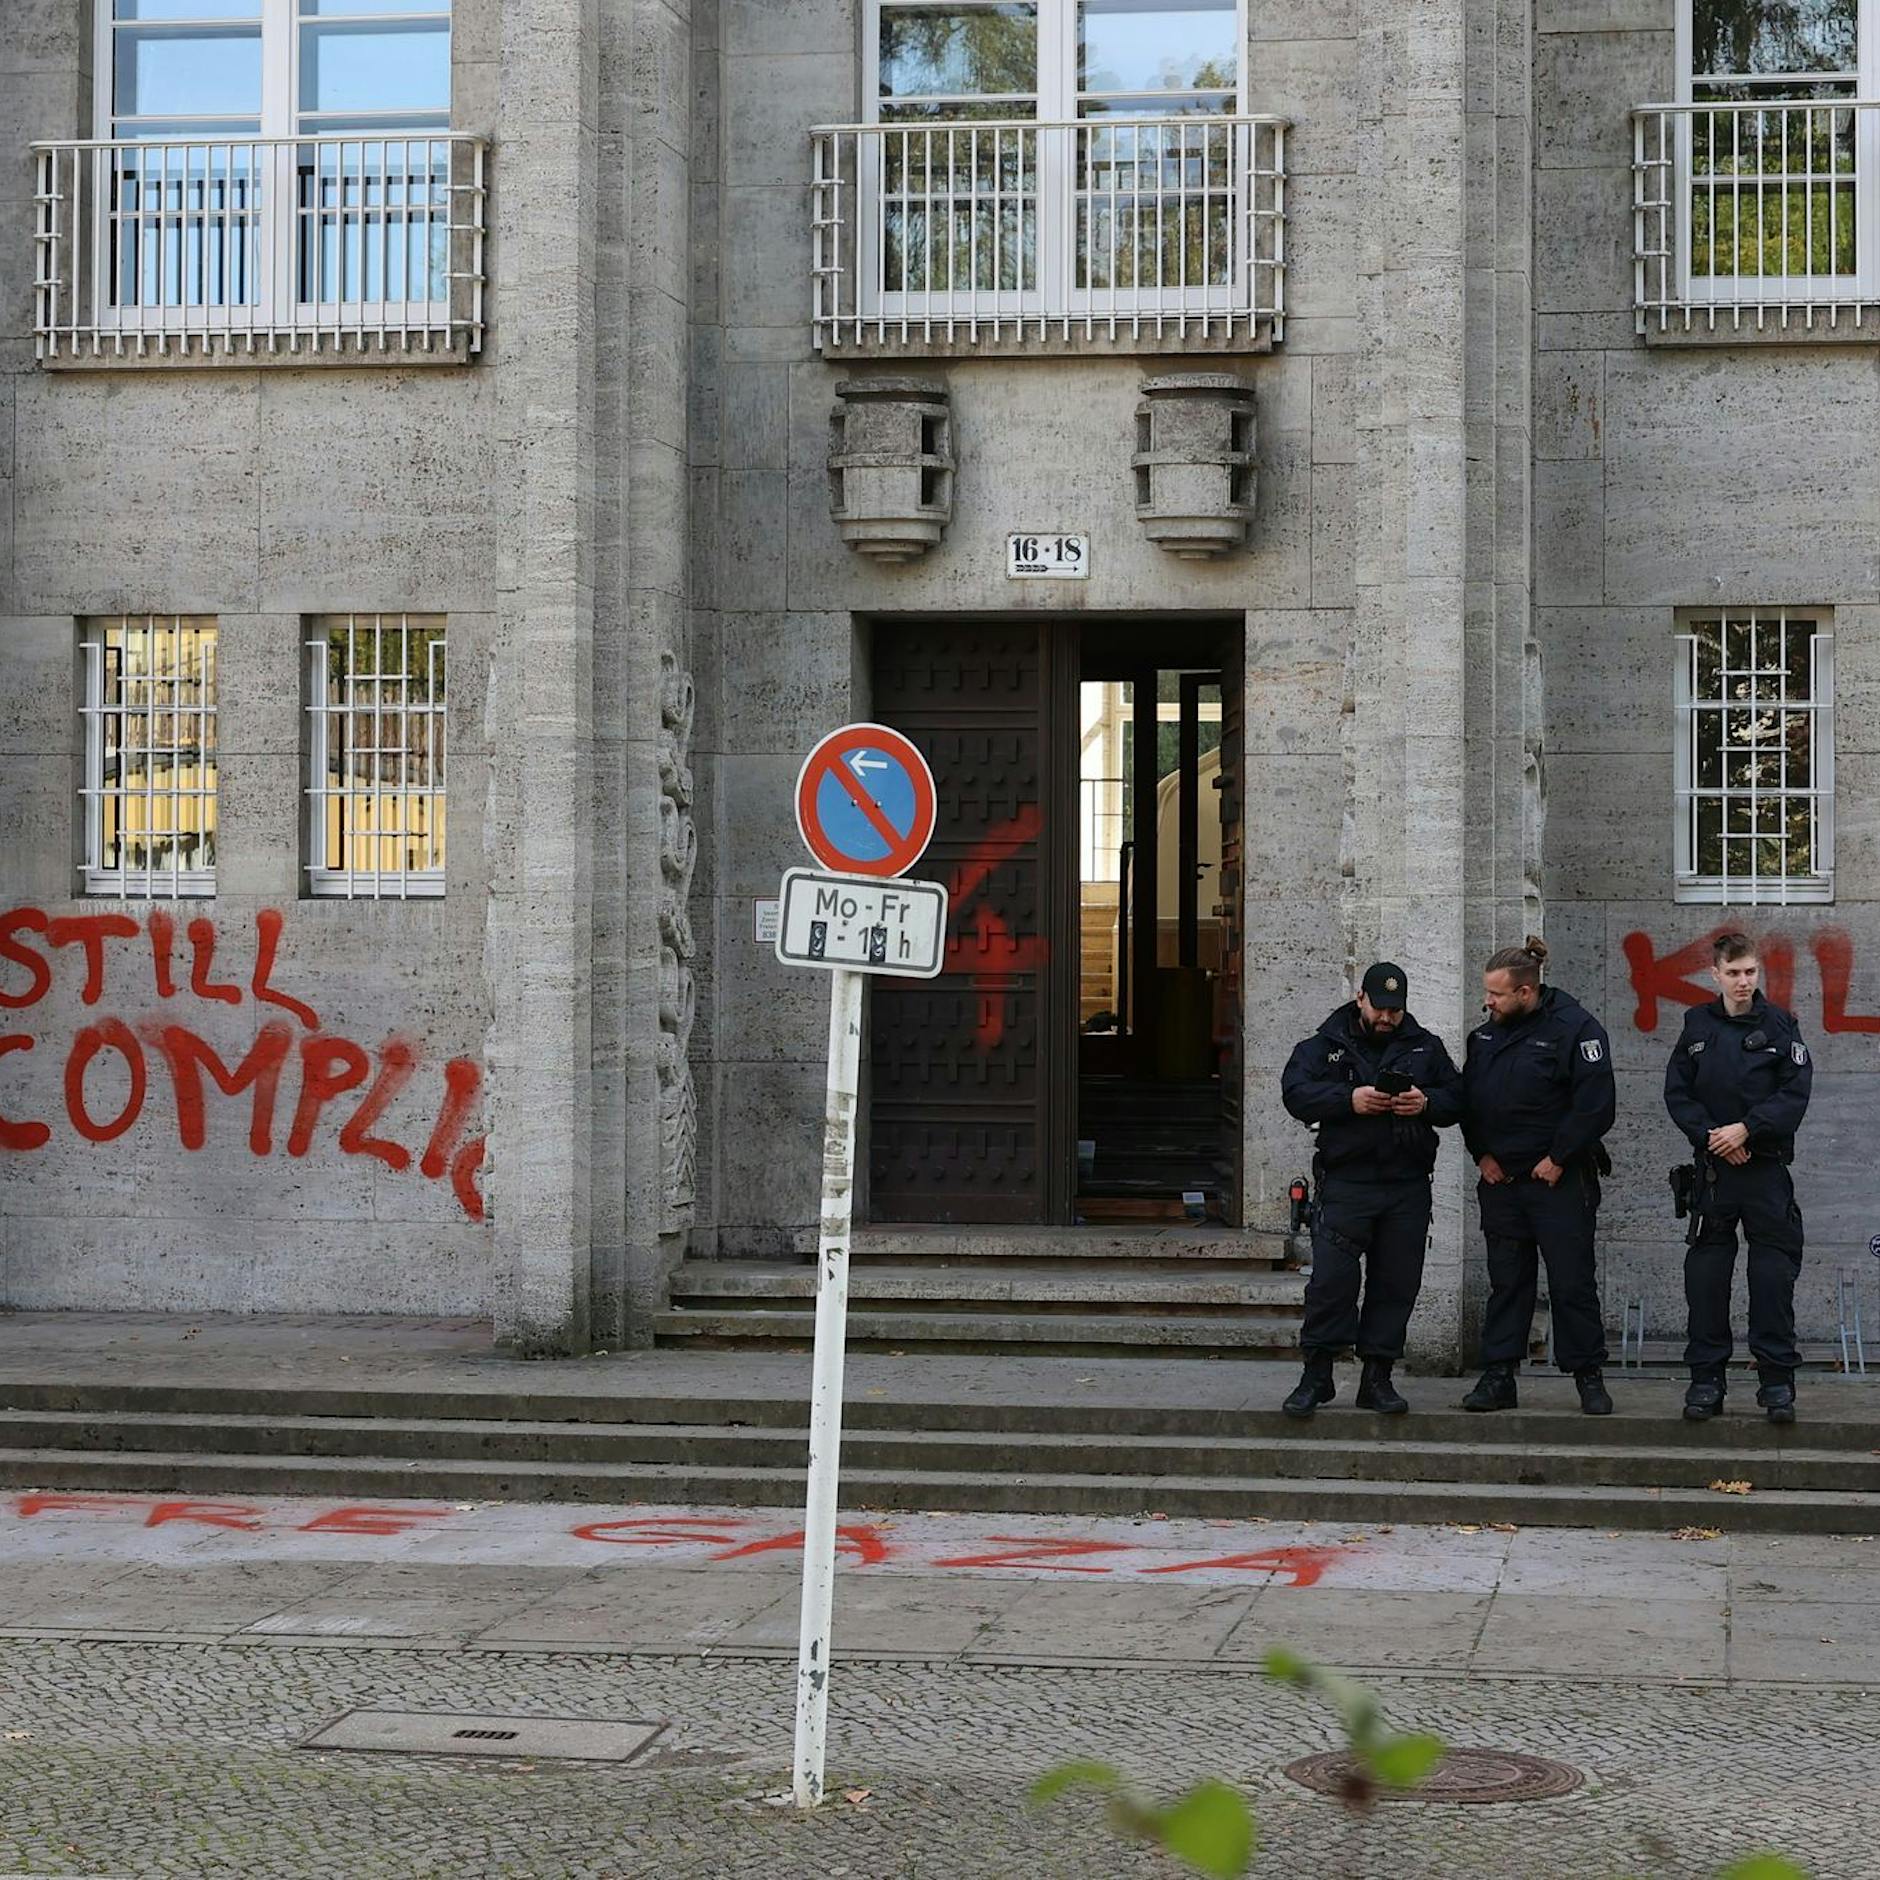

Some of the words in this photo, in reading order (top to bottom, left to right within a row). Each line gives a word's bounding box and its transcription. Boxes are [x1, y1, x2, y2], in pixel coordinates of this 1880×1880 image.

[0, 908, 318, 1030] STILL
[899, 930, 910, 959] h
[570, 1517, 1365, 1588] GAZA
